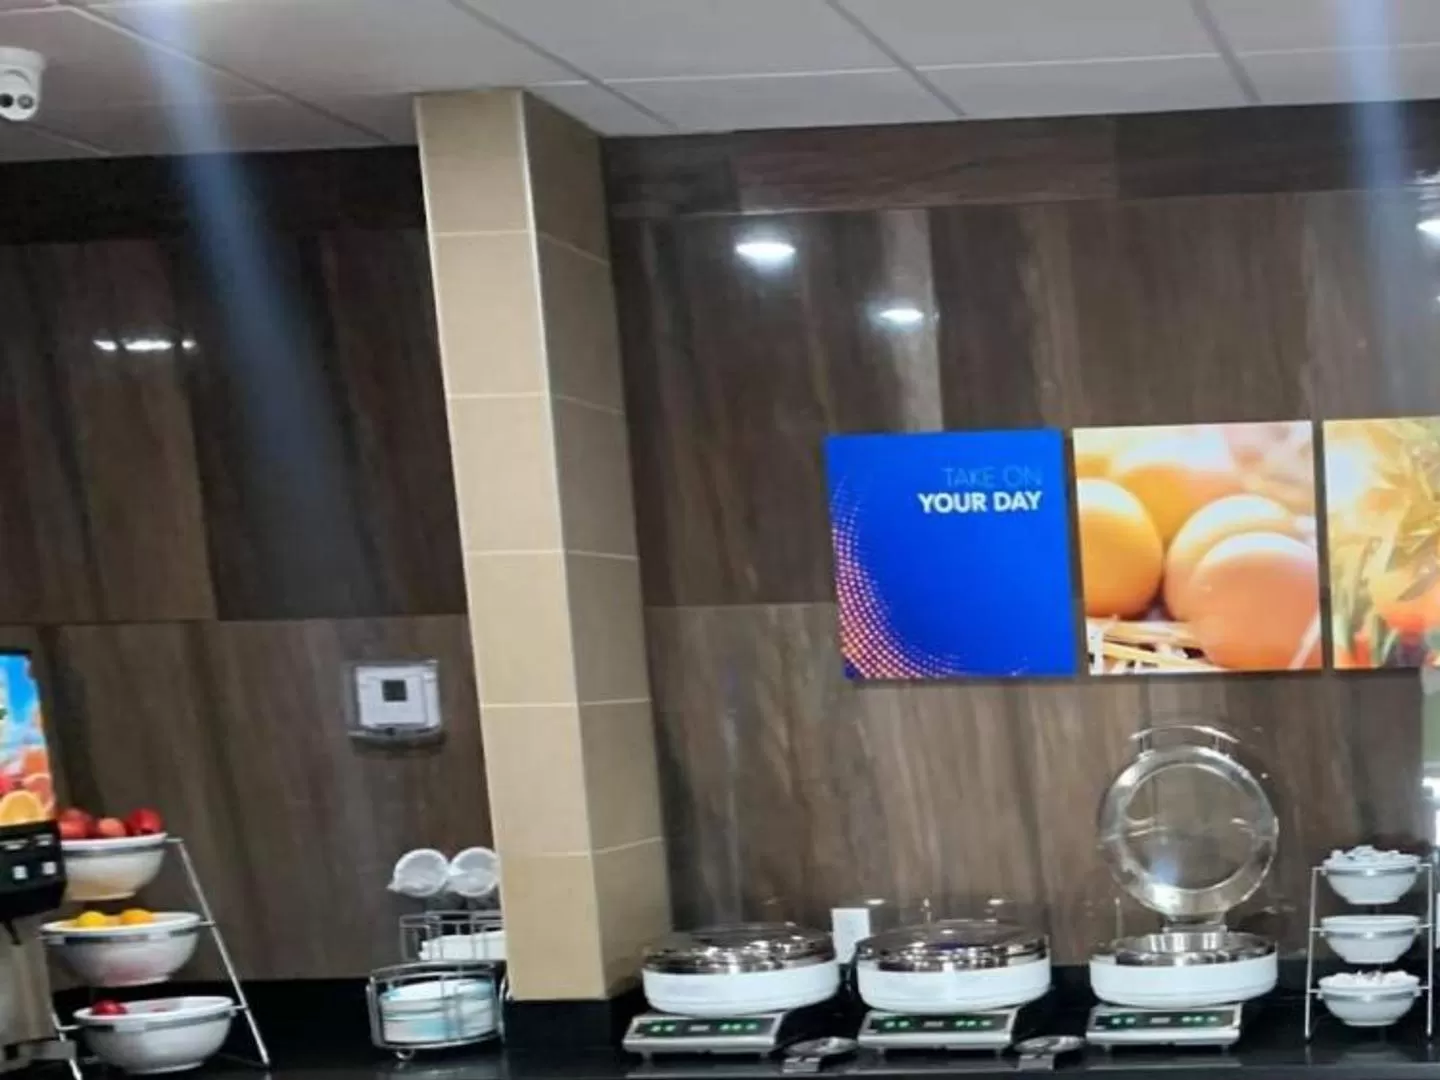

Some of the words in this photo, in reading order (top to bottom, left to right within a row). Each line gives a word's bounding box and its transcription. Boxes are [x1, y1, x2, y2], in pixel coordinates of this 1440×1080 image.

[942, 466, 996, 488] TAKE
[1002, 464, 1042, 487] ON
[917, 491, 987, 514] YOUR
[993, 490, 1043, 512] DAY
